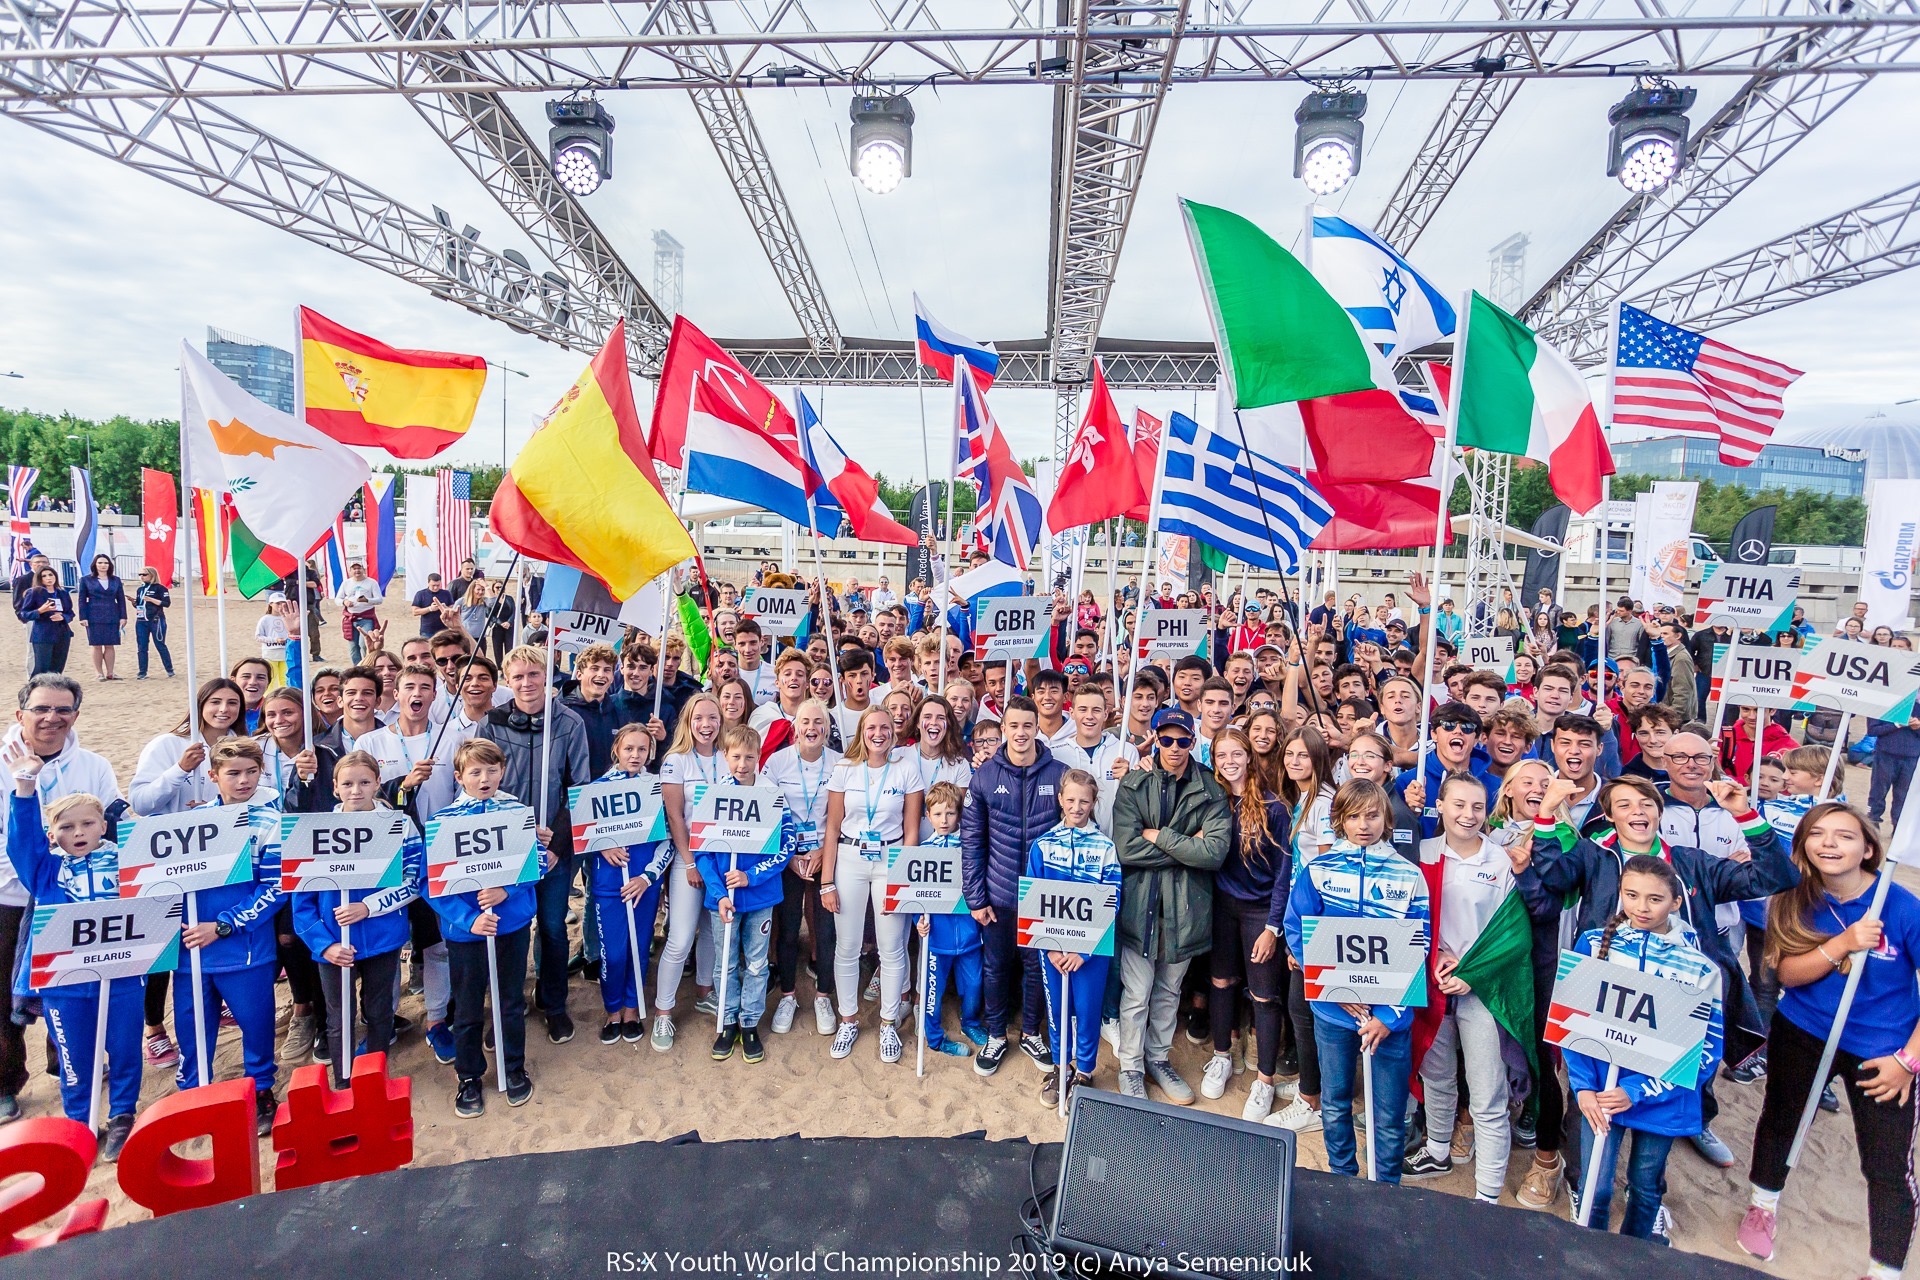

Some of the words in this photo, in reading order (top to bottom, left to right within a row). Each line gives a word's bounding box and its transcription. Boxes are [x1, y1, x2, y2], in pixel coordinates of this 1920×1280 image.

[918, 524, 929, 582] ercedes-Benz
[1894, 522, 1916, 571] GAZPROM
[1724, 575, 1774, 602] THA
[756, 596, 797, 615] OMA
[1727, 605, 1762, 615] THAILAND
[572, 613, 610, 636] JPN
[994, 608, 1036, 631] GBR
[1157, 619, 1188, 637] PHI
[993, 638, 1012, 647] GREAT
[1012, 637, 1034, 646] BRITAIN
[1471, 646, 1500, 663] POL
[1737, 657, 1792, 682] TUR
[1825, 651, 1890, 687] USA
[1751, 686, 1781, 695] TURKEY
[1841, 687, 1858, 698] USA
[591, 791, 642, 820] NED
[713, 797, 762, 823] FRA
[595, 820, 644, 835] NETHERLANDS
[722, 828, 751, 838] FRANCE
[150, 823, 219, 859] CYP
[312, 827, 374, 856] ESP
[454, 825, 508, 858] EST
[165, 861, 208, 877] CYPRUS
[329, 863, 356, 873] SPAIN
[465, 860, 503, 874] ESTONIA
[907, 859, 953, 884] GRE
[915, 890, 942, 899] GREECE
[1039, 893, 1094, 922] HKG
[71, 914, 146, 948] BEL
[1045, 926, 1065, 937] HONG
[1066, 928, 1086, 939] KONG
[83, 950, 132, 965] BELARUS
[1336, 934, 1390, 965] ISR
[1348, 975, 1380, 985] ISRAEL
[1595, 980, 1658, 1030] ITA
[1604, 1027, 1638, 1046] ITALY
